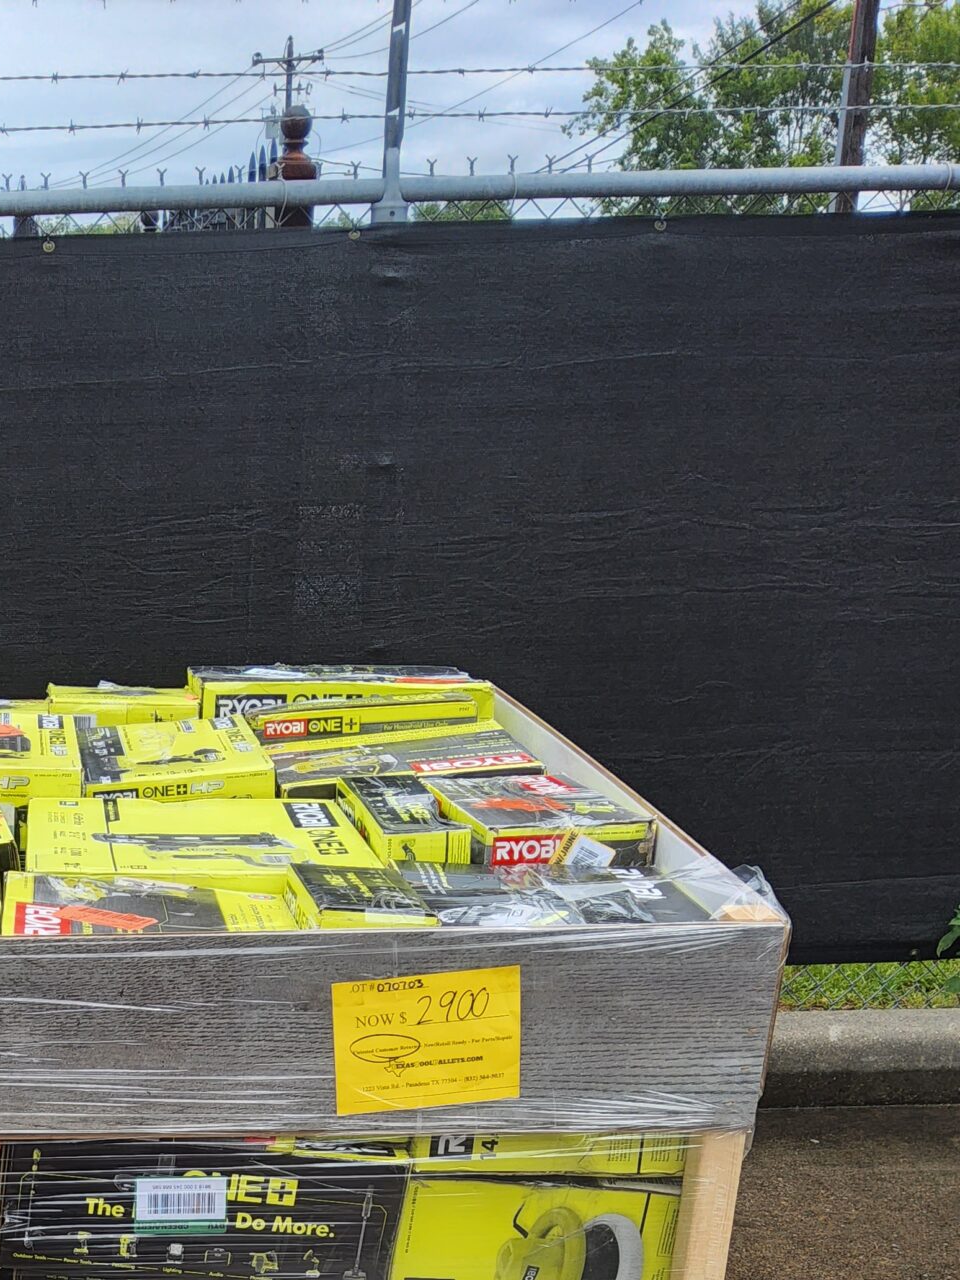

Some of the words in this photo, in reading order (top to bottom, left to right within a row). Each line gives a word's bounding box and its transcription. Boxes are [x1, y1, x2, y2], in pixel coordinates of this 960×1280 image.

[266, 721, 305, 735] RYOBI
[419, 756, 528, 770] RYOBI
[143, 784, 187, 798] ONE+
[191, 781, 224, 794] HP
[291, 803, 332, 827] RYOBI
[496, 839, 561, 858] RYOBI
[350, 984, 367, 993] OT
[377, 979, 424, 992] 070703
[356, 1013, 395, 1028] NOW
[400, 1012, 407, 1024] $
[417, 987, 490, 1025] 2900
[86, 1198, 125, 1218] The
[236, 1213, 266, 1231] Do
[272, 1216, 335, 1238] More.
